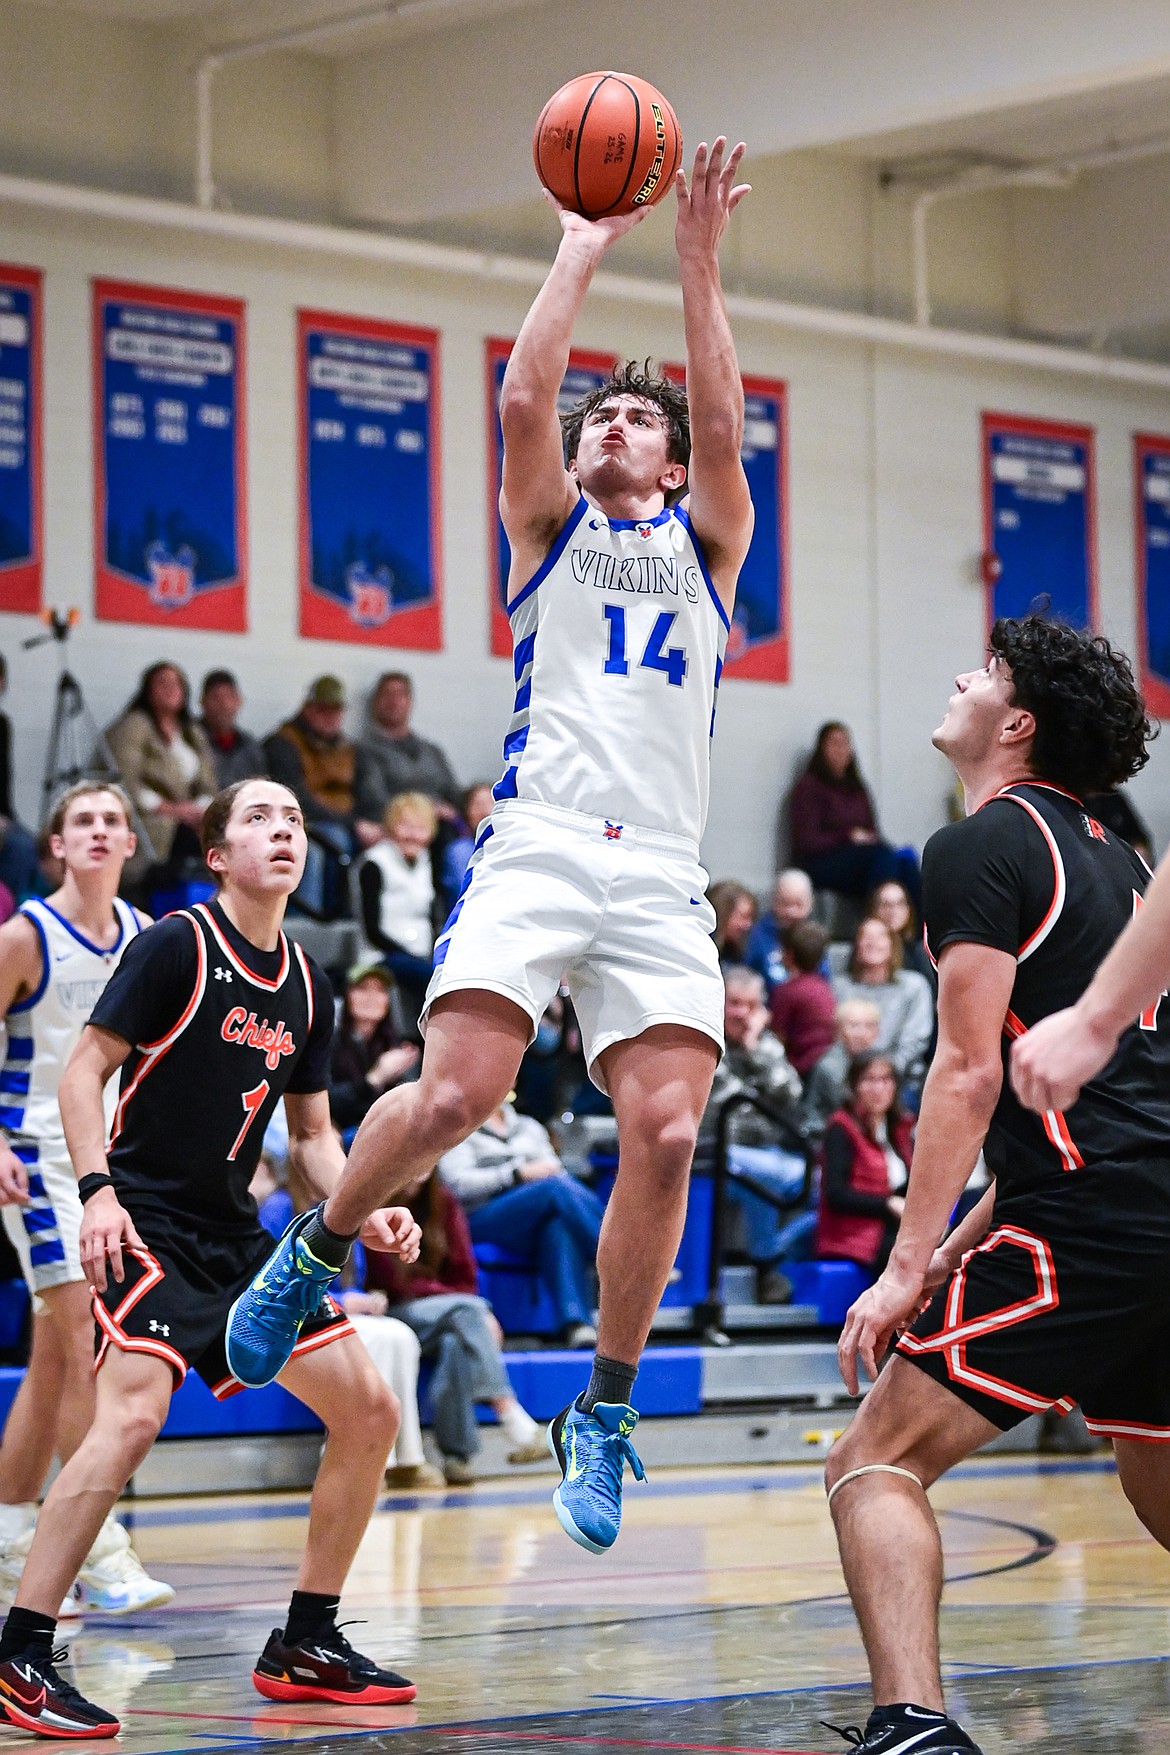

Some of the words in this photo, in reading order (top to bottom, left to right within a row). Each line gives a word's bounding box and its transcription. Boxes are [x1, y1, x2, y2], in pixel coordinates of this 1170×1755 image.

[613, 132, 627, 164] GAME
[602, 602, 689, 688] 14
[221, 1006, 296, 1070] Chiefs
[226, 1079, 270, 1161] 1
